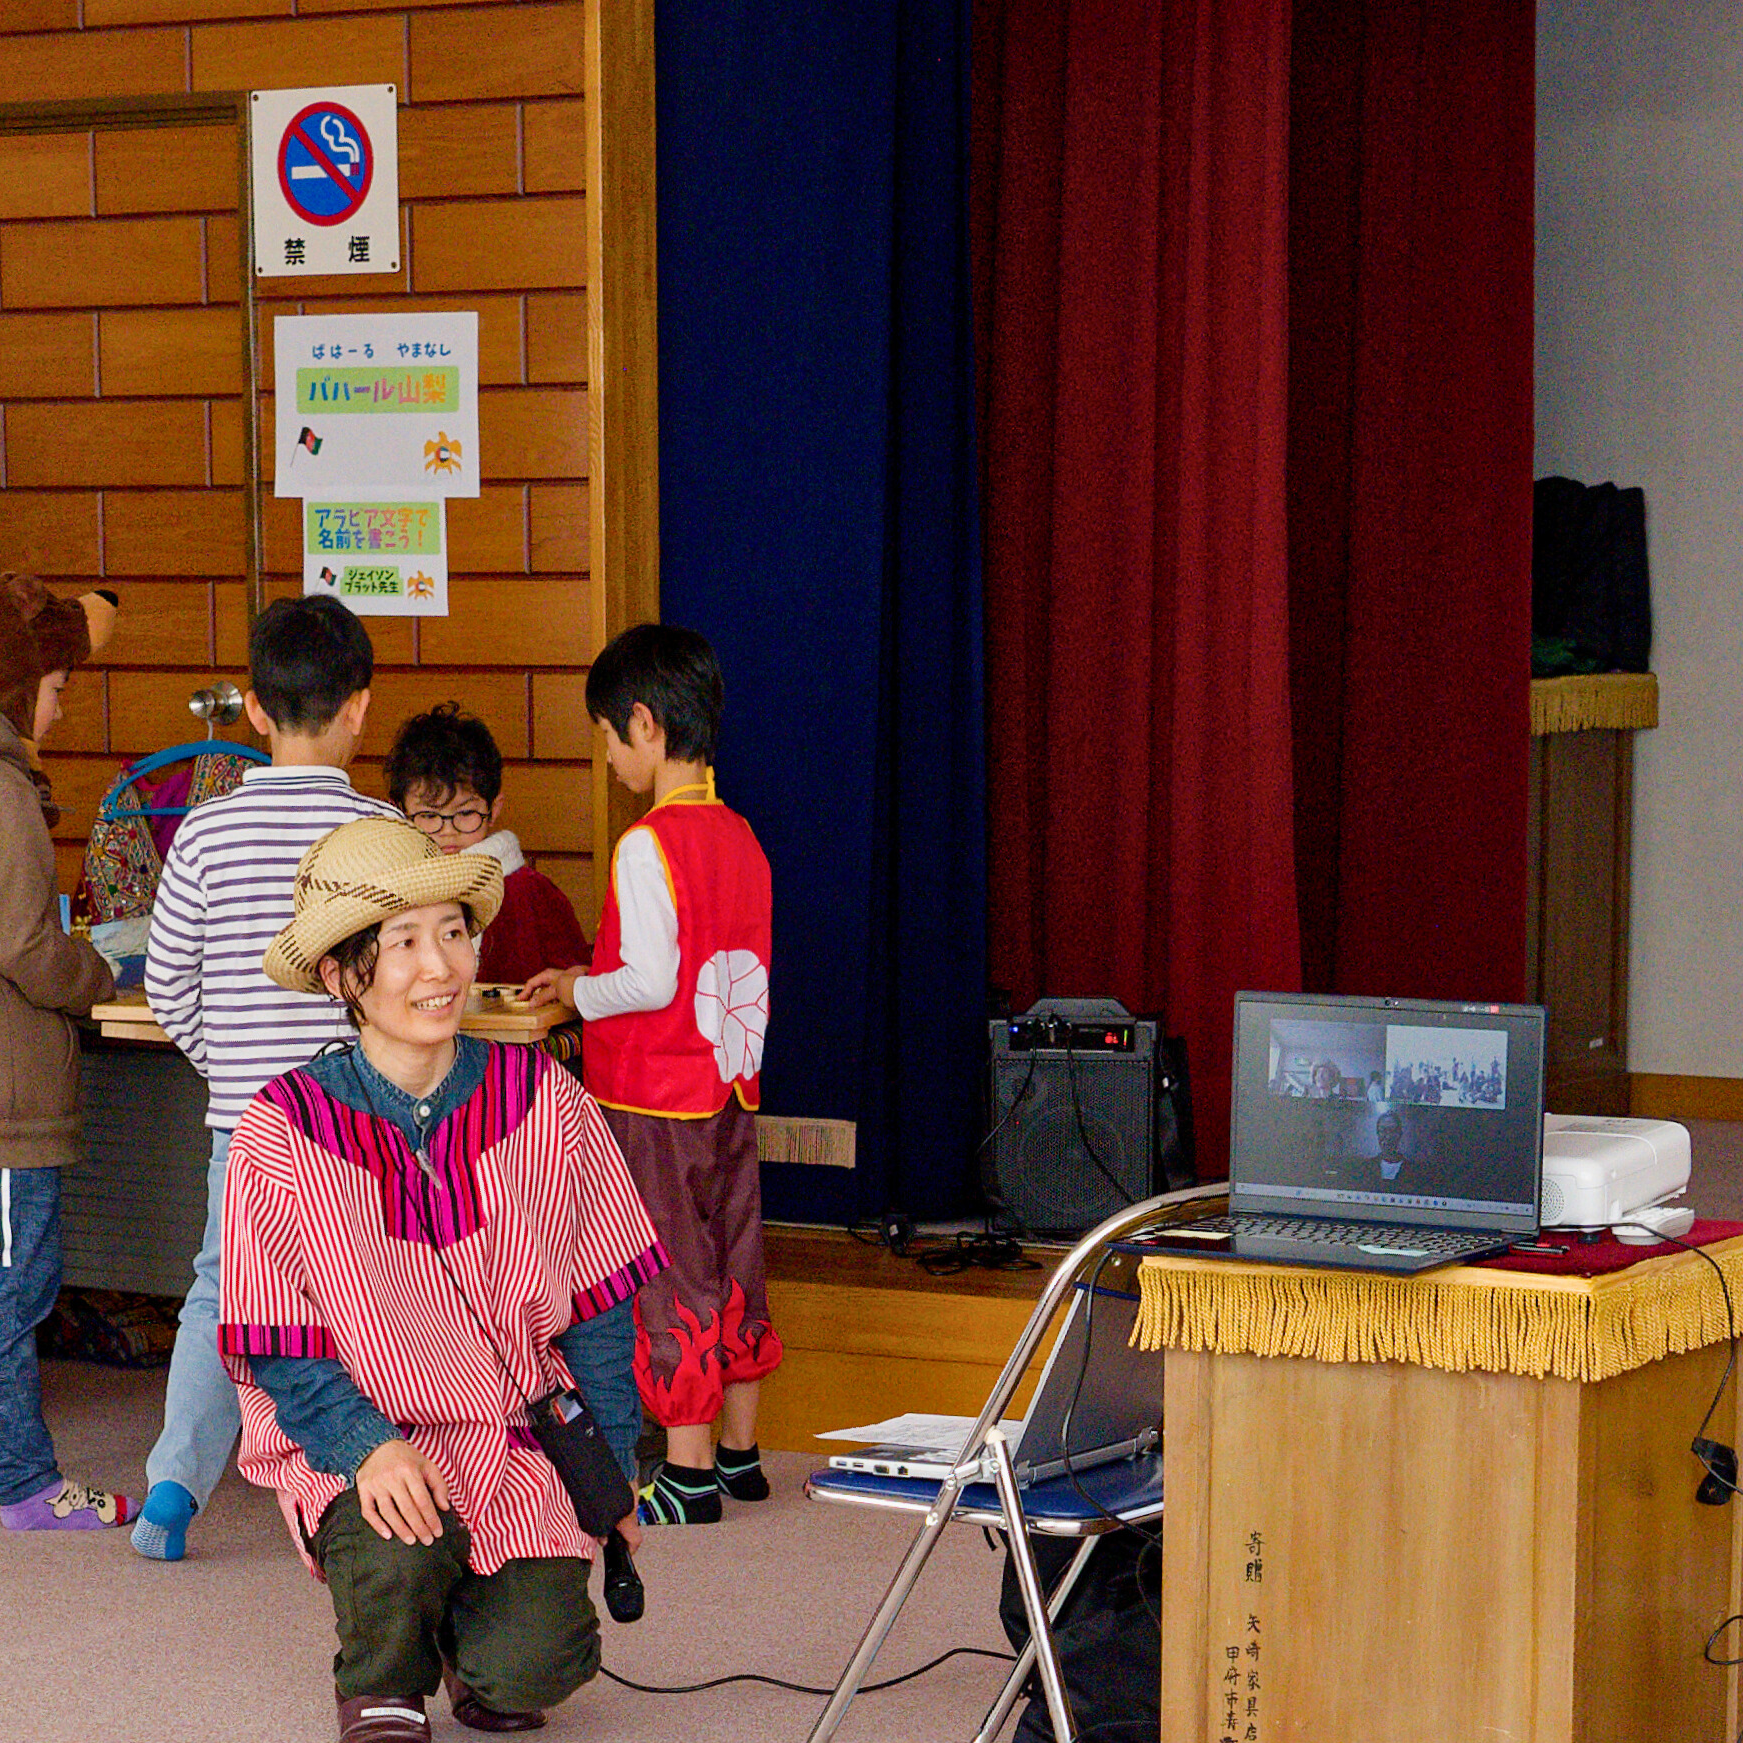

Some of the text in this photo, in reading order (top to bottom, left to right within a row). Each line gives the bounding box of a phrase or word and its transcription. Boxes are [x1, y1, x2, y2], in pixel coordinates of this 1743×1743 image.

[283, 235, 370, 265] 禁煙
[397, 342, 451, 358] やまなし
[309, 374, 446, 404] バハール山梨
[315, 507, 431, 528] アラビア文字で
